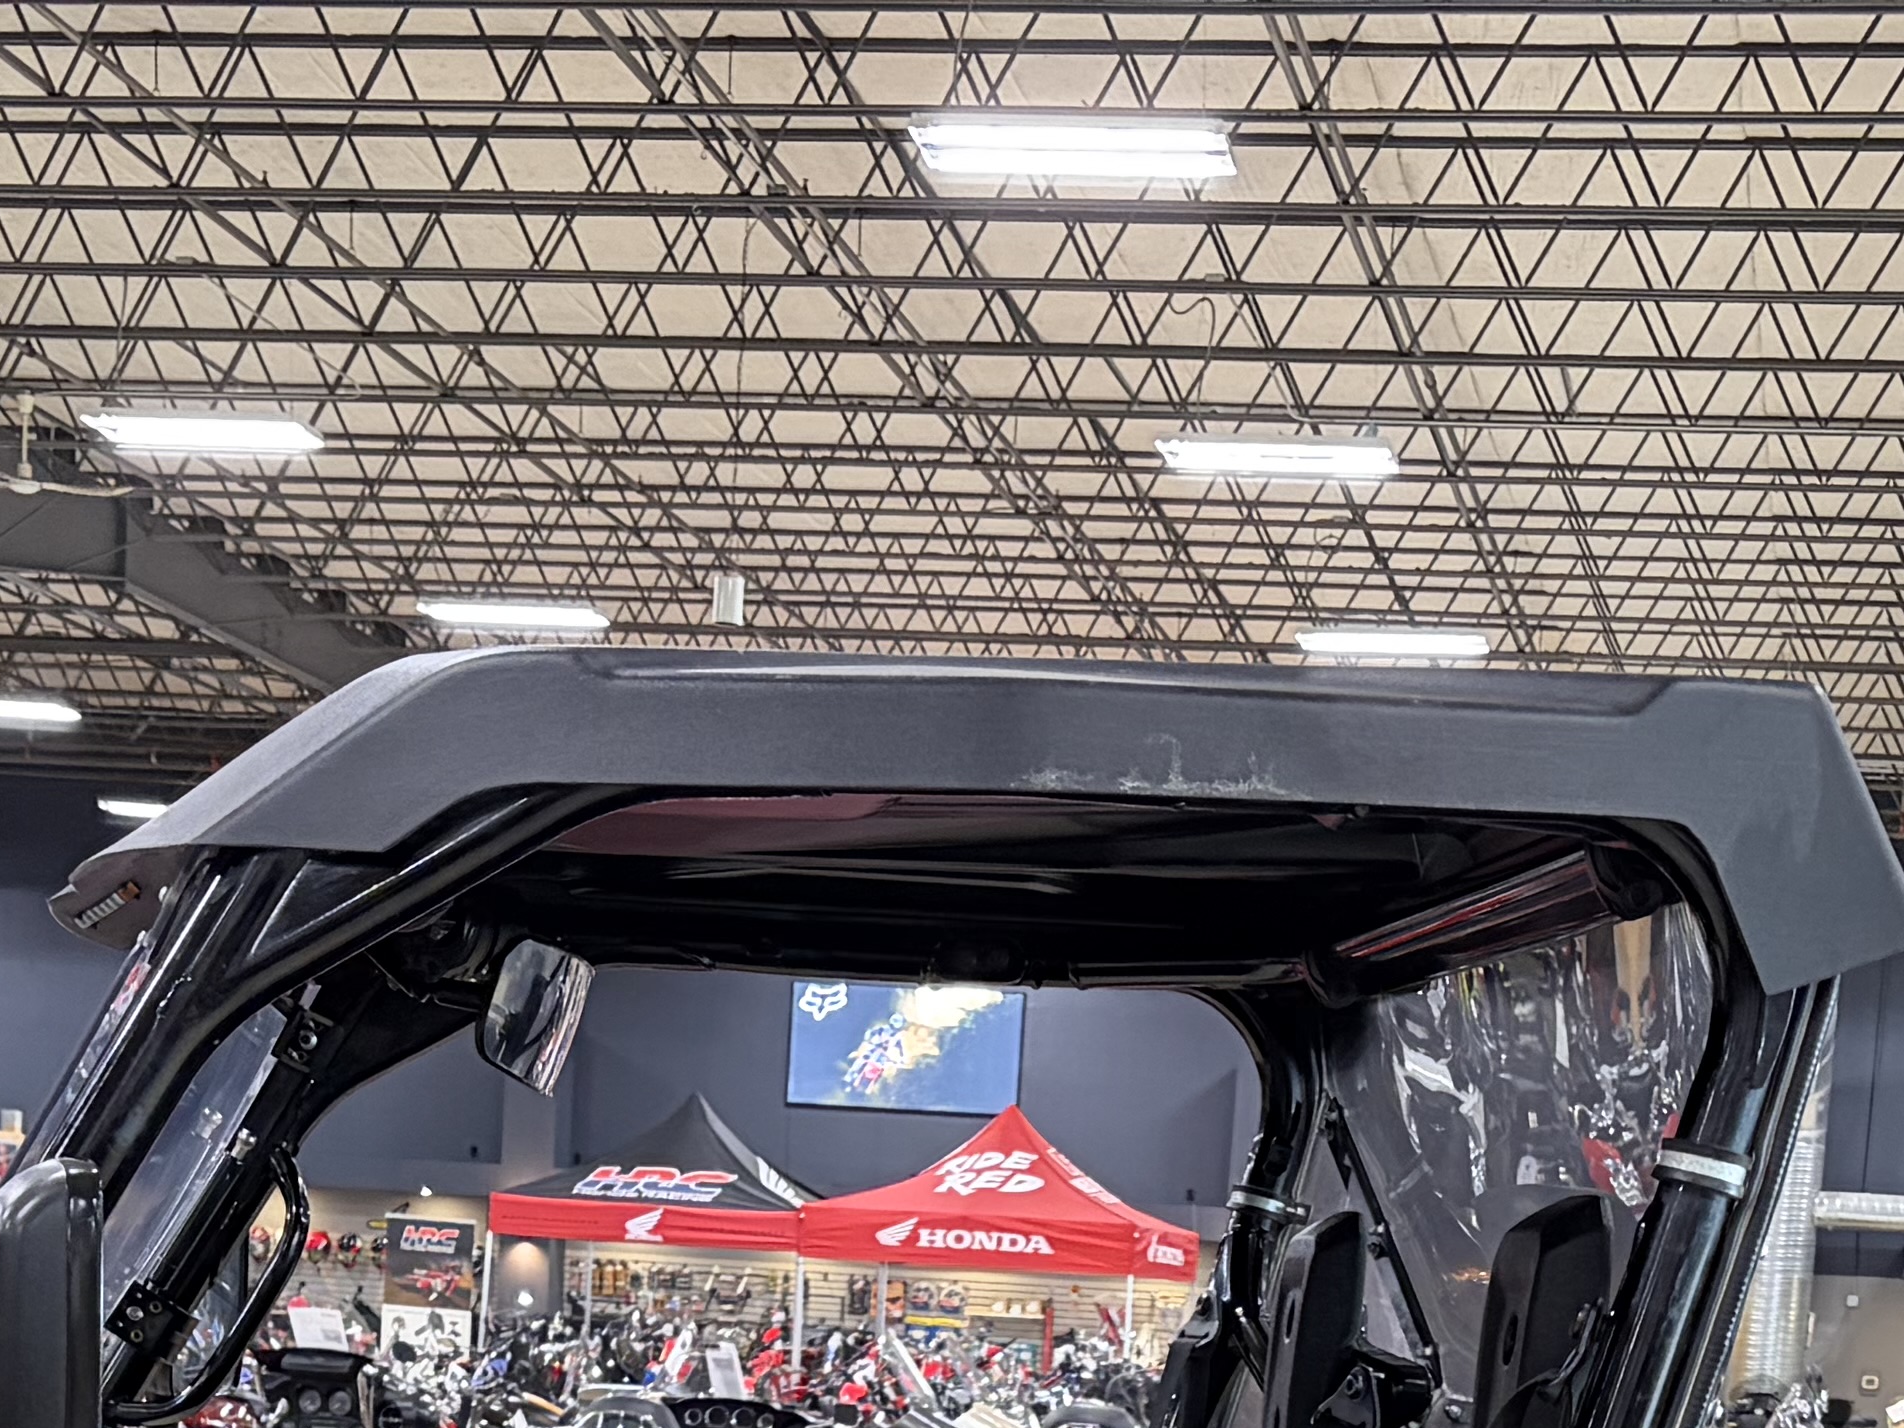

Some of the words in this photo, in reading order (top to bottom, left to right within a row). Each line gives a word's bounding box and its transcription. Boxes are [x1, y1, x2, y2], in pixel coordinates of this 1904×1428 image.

[934, 1150, 1039, 1176] RIDE
[576, 1166, 739, 1194] HRC
[933, 1170, 1045, 1196] RED
[400, 1224, 460, 1248] HRC
[916, 1228, 1055, 1255] HONDA
